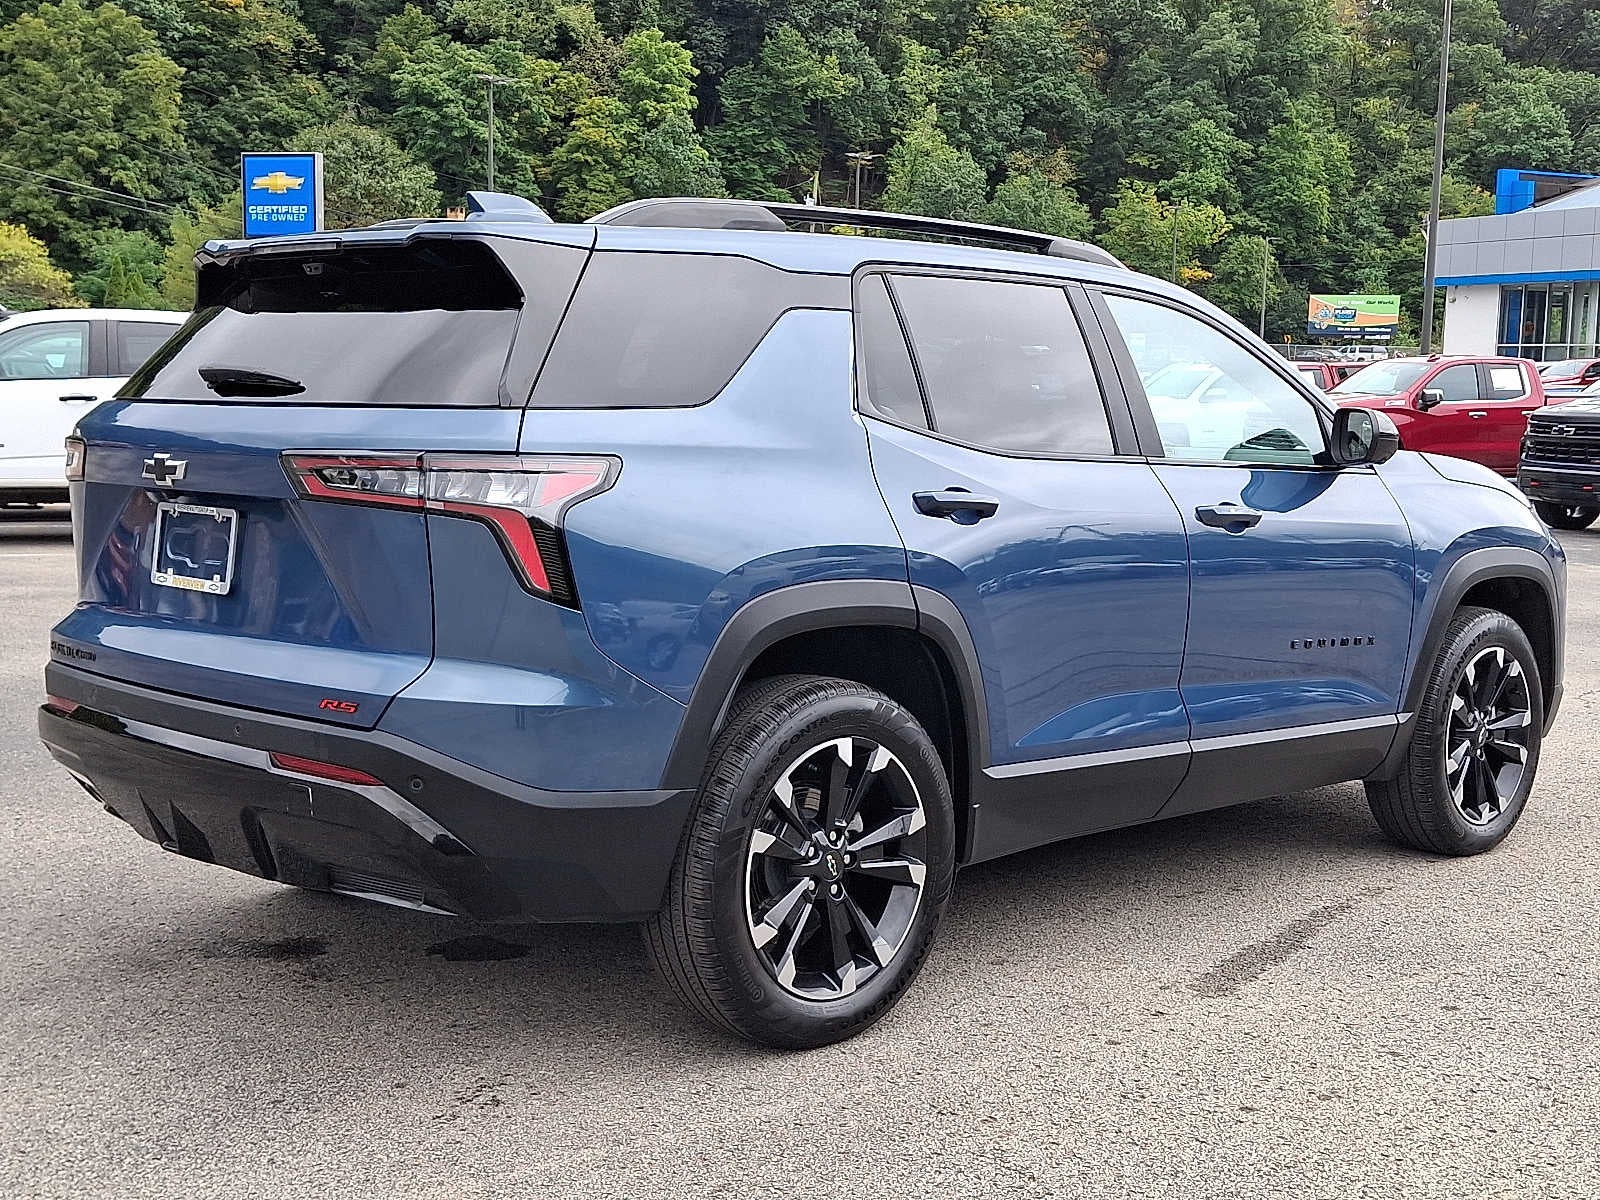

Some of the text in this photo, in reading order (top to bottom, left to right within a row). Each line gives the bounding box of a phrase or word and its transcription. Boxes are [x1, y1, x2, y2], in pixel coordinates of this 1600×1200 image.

[248, 205, 308, 214] CERTIFIED
[1289, 636, 1376, 650] EQUINOX
[318, 698, 360, 714] RS
